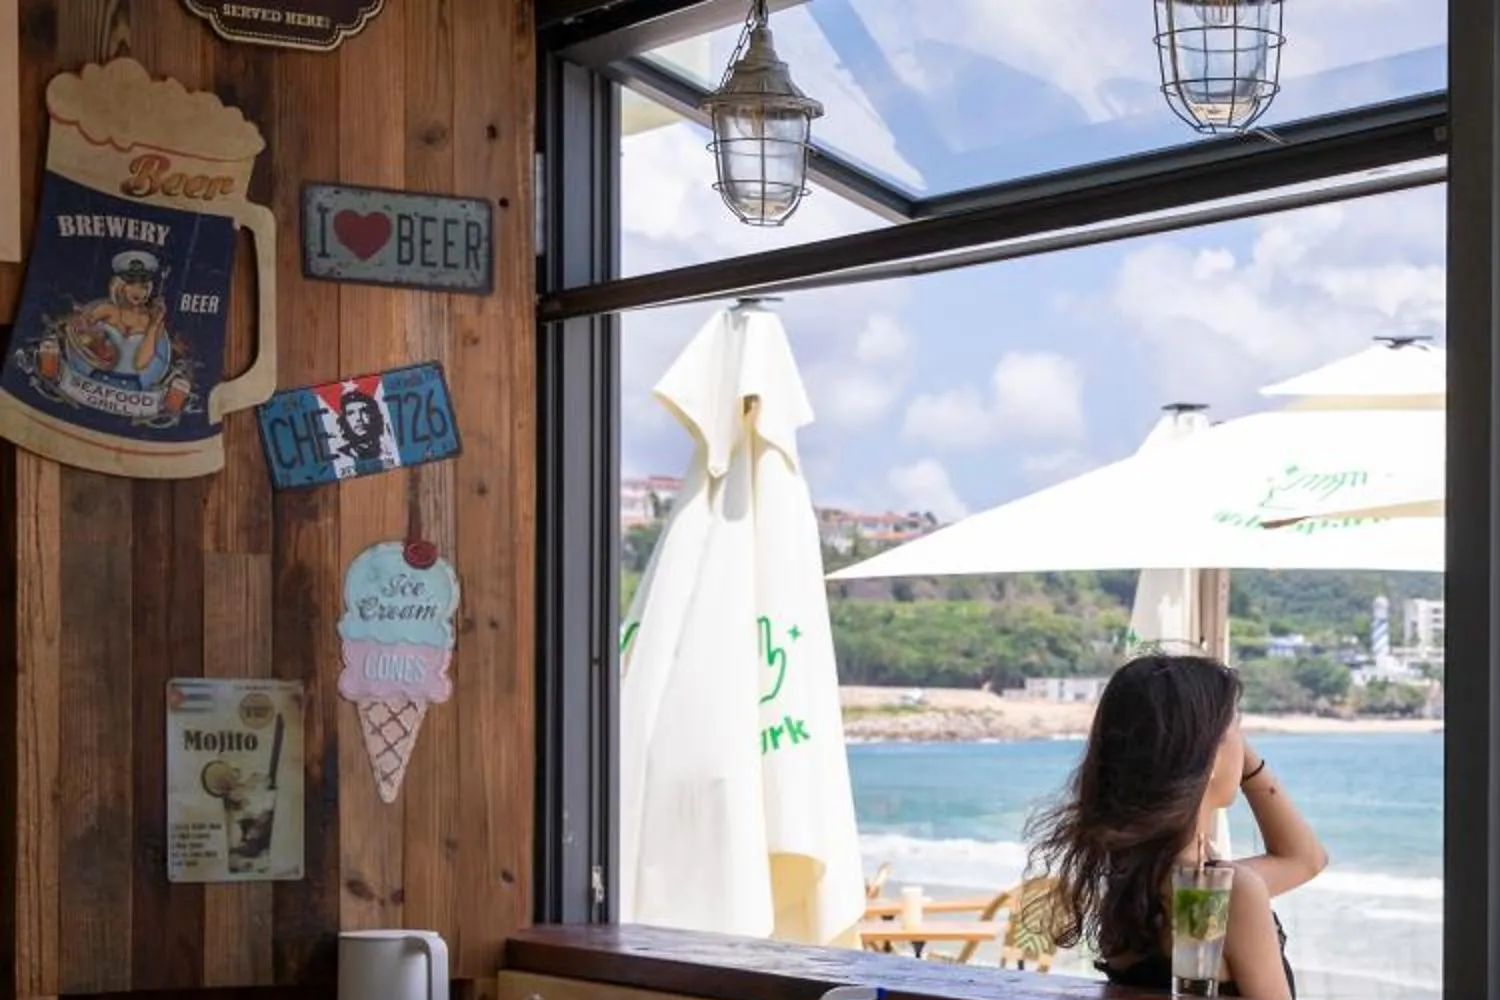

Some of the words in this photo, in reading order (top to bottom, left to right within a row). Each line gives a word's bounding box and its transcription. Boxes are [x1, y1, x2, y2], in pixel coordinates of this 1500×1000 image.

[222, 3, 282, 22] SERVED
[120, 153, 235, 200] Beer
[57, 214, 171, 246] BREWERY
[316, 202, 331, 258] I
[397, 213, 482, 271] BEER
[180, 293, 219, 314] BEER
[72, 376, 154, 407] SEAFOOD
[269, 407, 341, 470] CHE
[381, 573, 425, 597] Ice
[356, 596, 438, 621] Cream
[183, 730, 258, 754] Mojito
